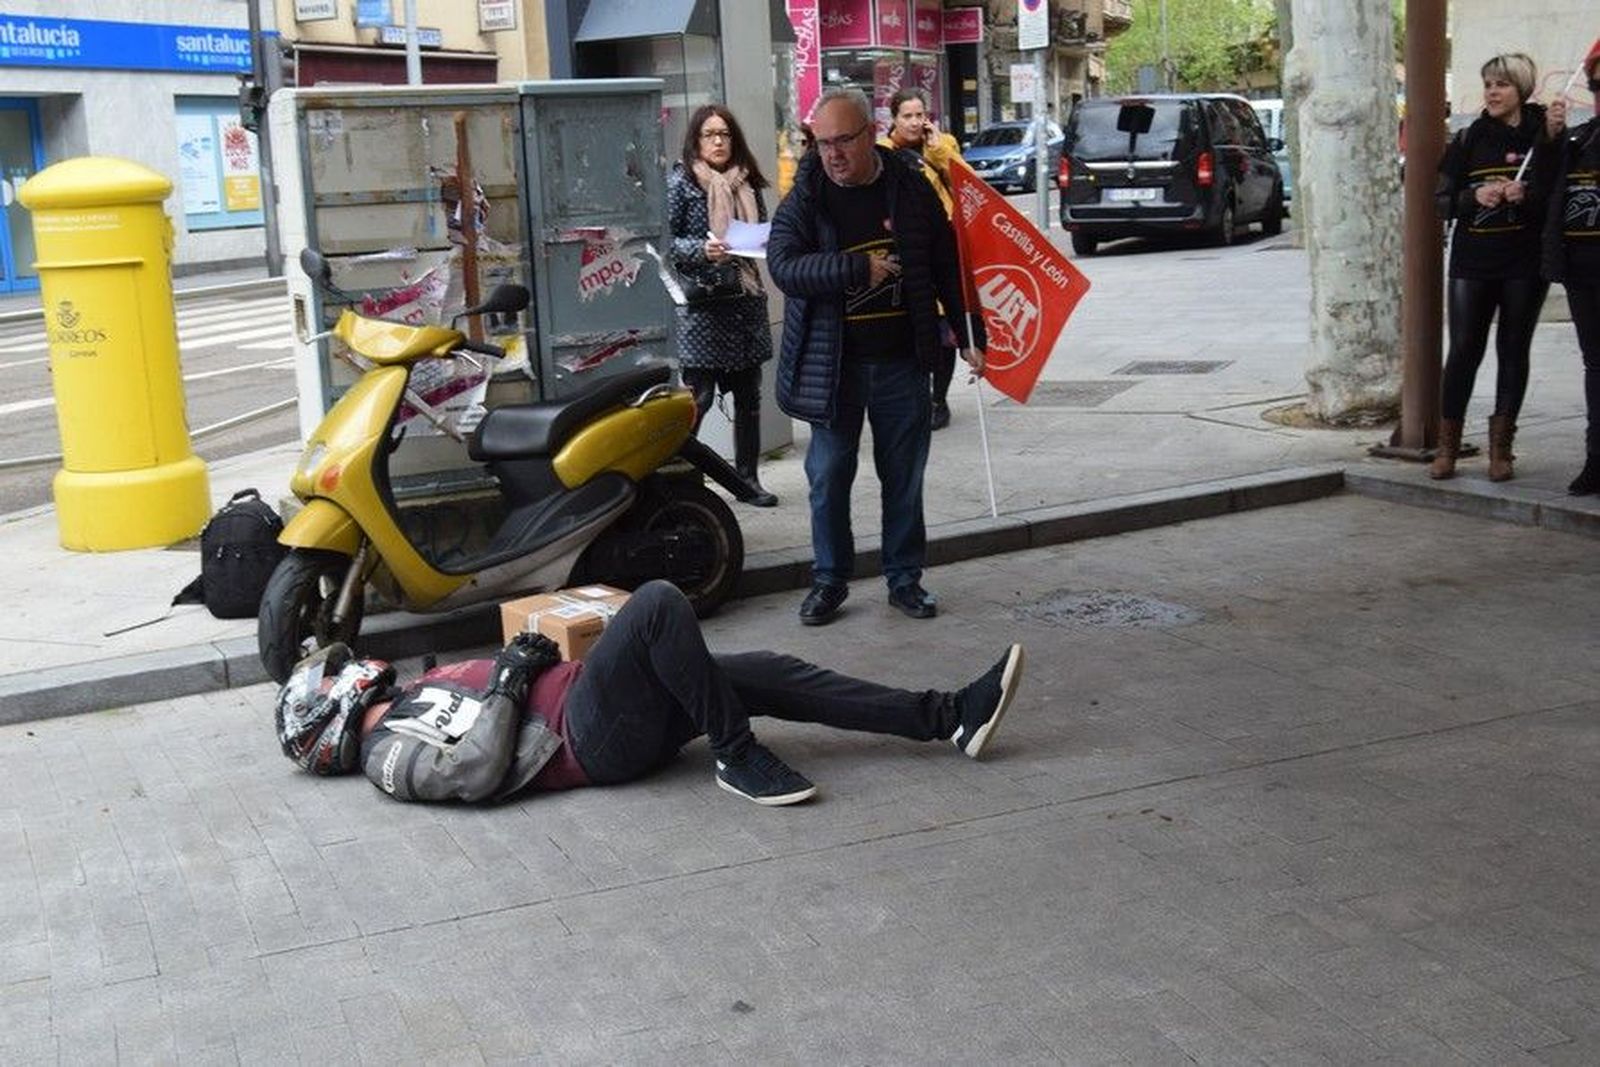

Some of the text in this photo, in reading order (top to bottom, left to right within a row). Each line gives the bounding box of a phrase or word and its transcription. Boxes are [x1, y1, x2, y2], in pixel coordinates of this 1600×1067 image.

[820, 14, 853, 26] CHAS
[176, 33, 251, 54] santaluc
[794, 8, 815, 79] MUCHAS
[992, 213, 1069, 289] Castilla y León
[978, 273, 1039, 341] UGT
[49, 329, 107, 344] ORREOS
